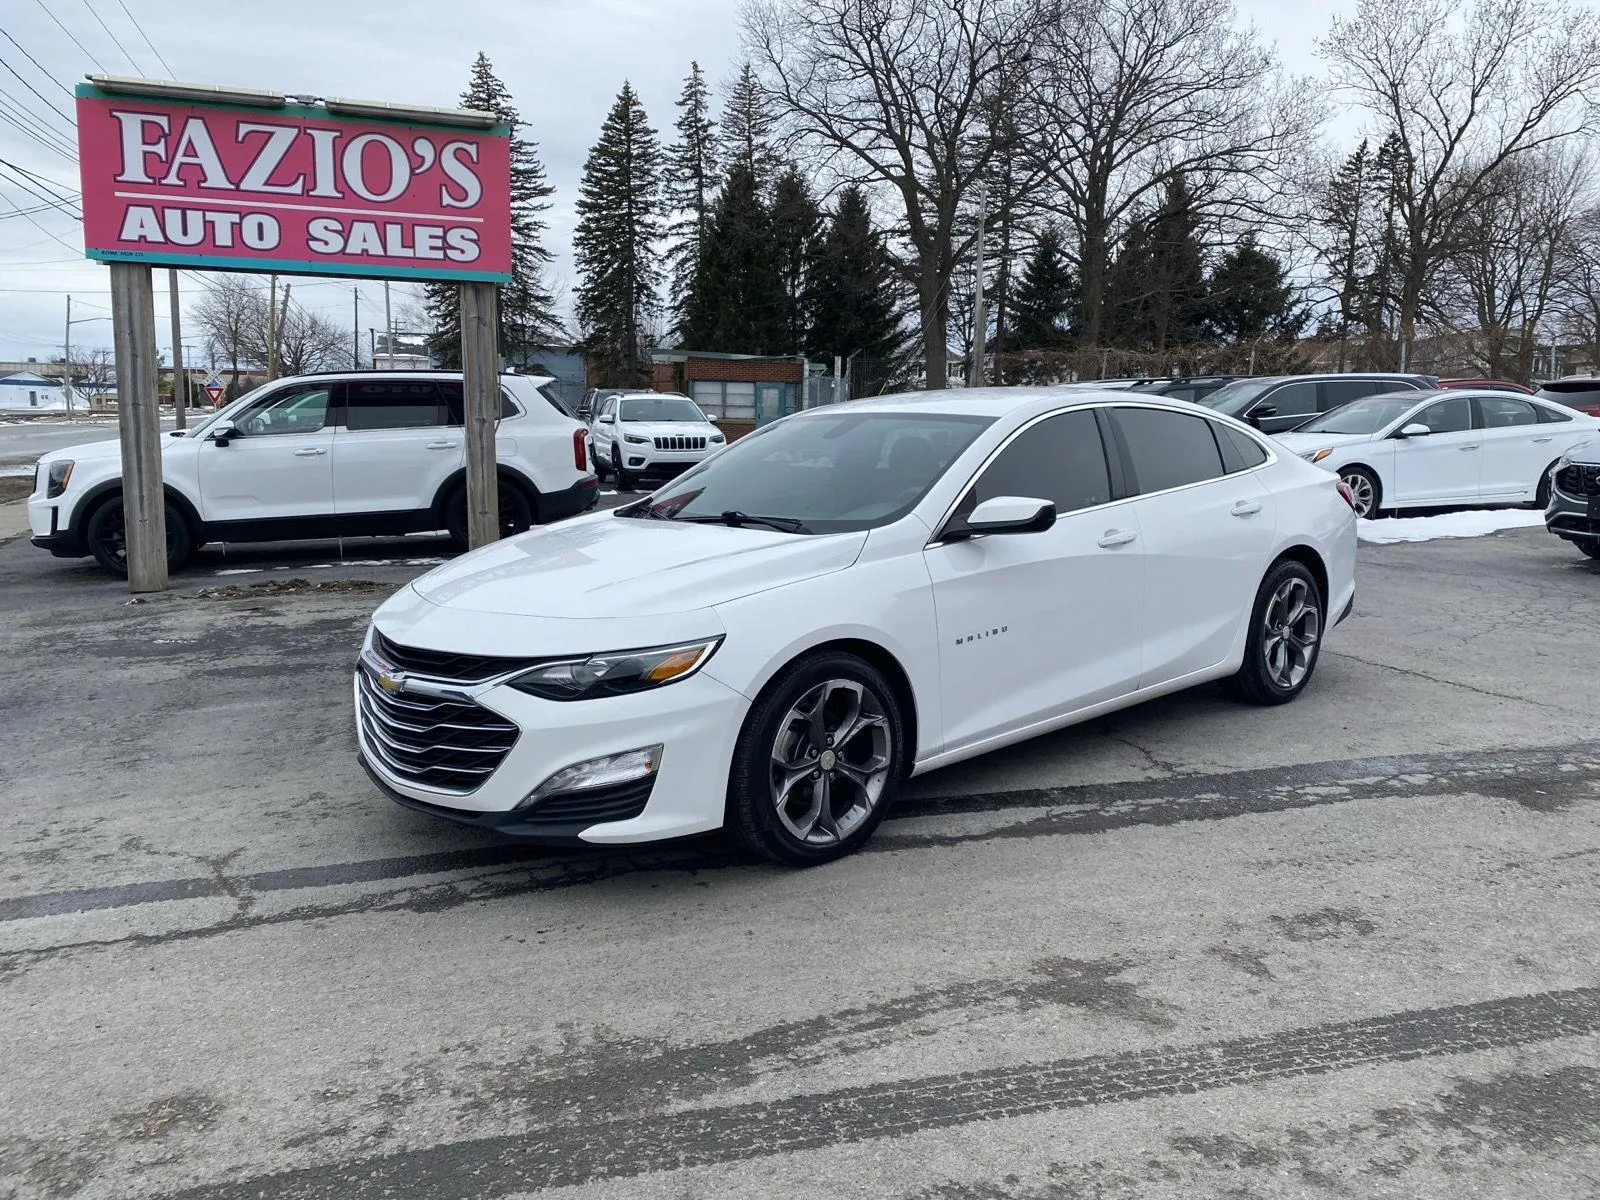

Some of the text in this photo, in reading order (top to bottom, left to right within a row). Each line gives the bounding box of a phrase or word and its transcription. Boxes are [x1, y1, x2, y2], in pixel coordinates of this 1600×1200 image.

[110, 109, 484, 209] FAZIO'S
[118, 204, 483, 263] AUTO SALES
[955, 625, 1008, 645] MALIBU
